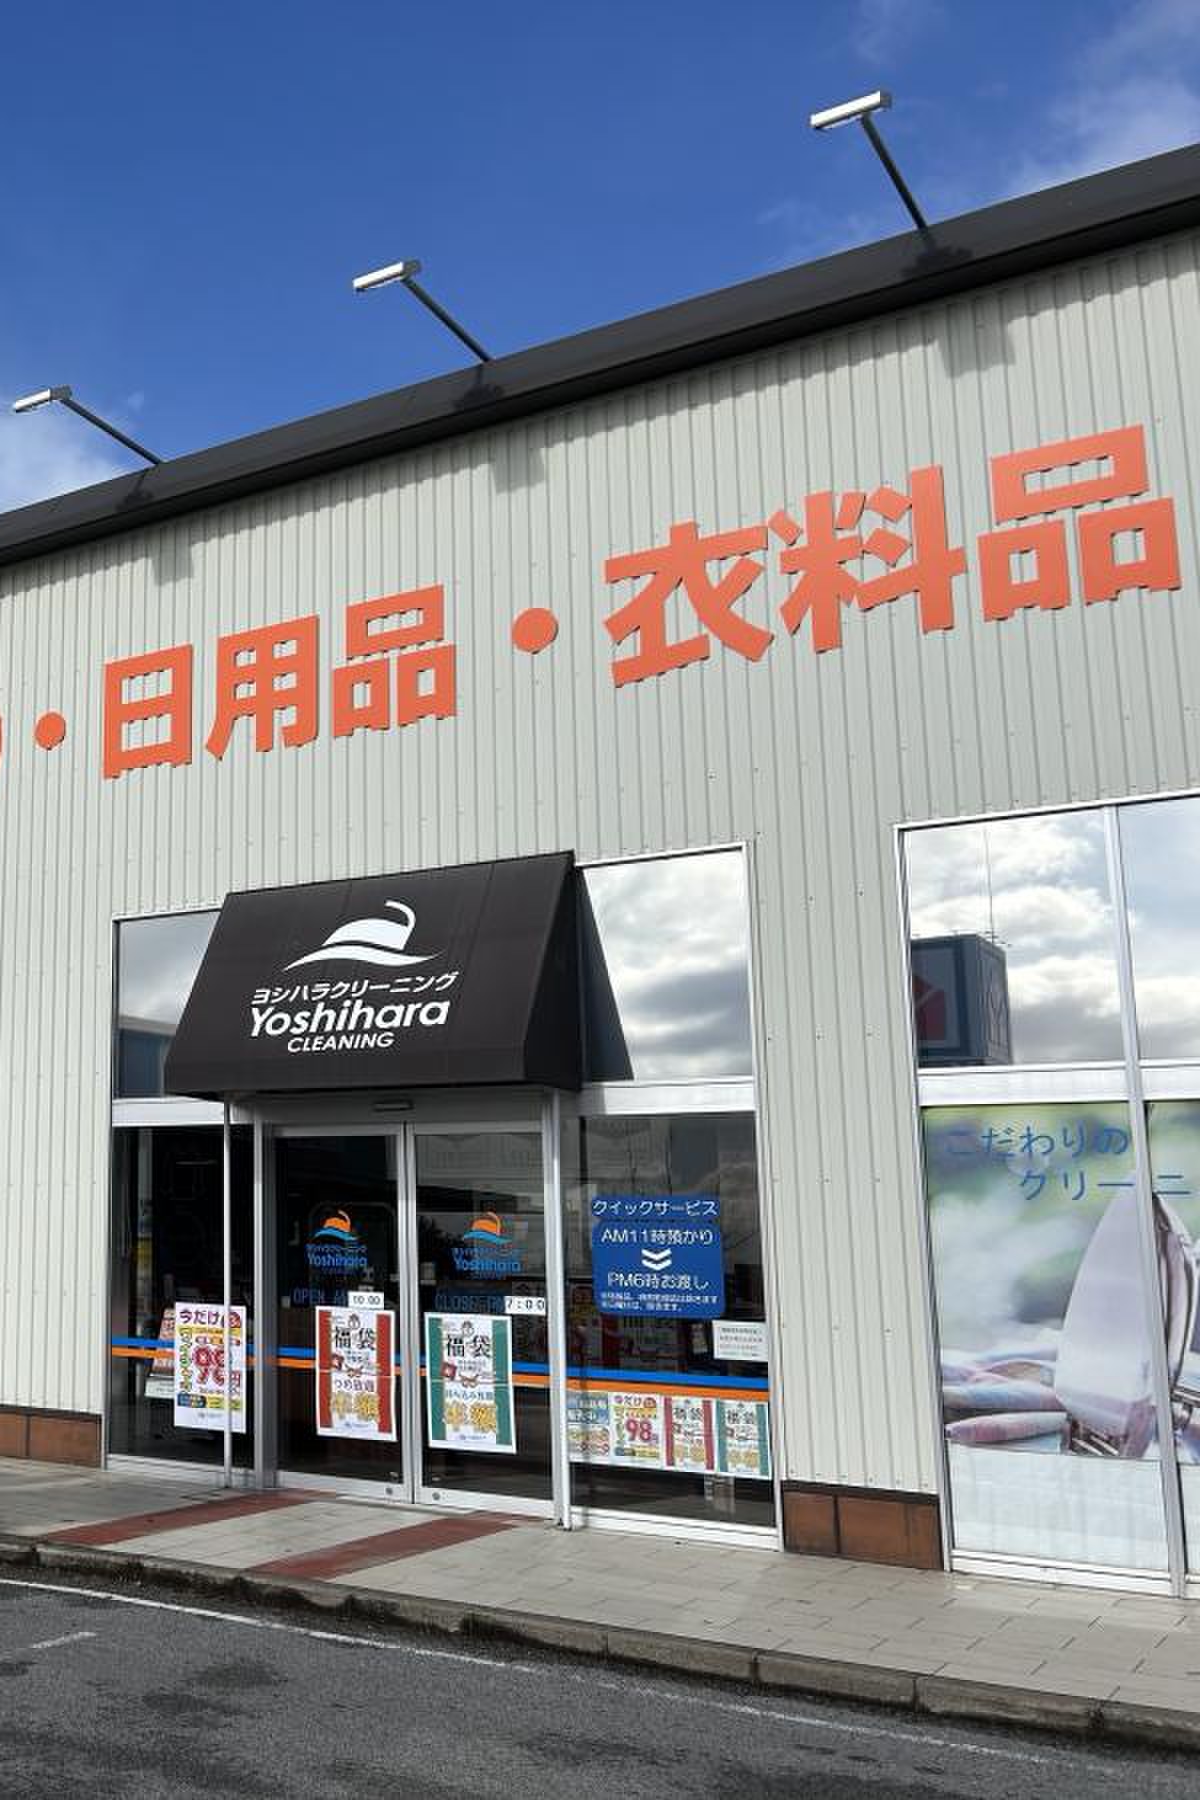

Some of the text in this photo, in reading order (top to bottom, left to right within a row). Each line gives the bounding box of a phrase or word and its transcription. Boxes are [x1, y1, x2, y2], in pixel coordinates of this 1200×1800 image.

[253, 972, 459, 1005] ヨシハラクリーニング
[249, 999, 450, 1037] Yoshihara
[287, 1032, 394, 1053] CLEANING
[945, 1124, 1130, 1160] こだわりの
[593, 1199, 718, 1217] クイックサービス
[334, 1326, 376, 1351] 福袋
[446, 1334, 491, 1358] 福袋
[626, 1418, 652, 1442] 98
